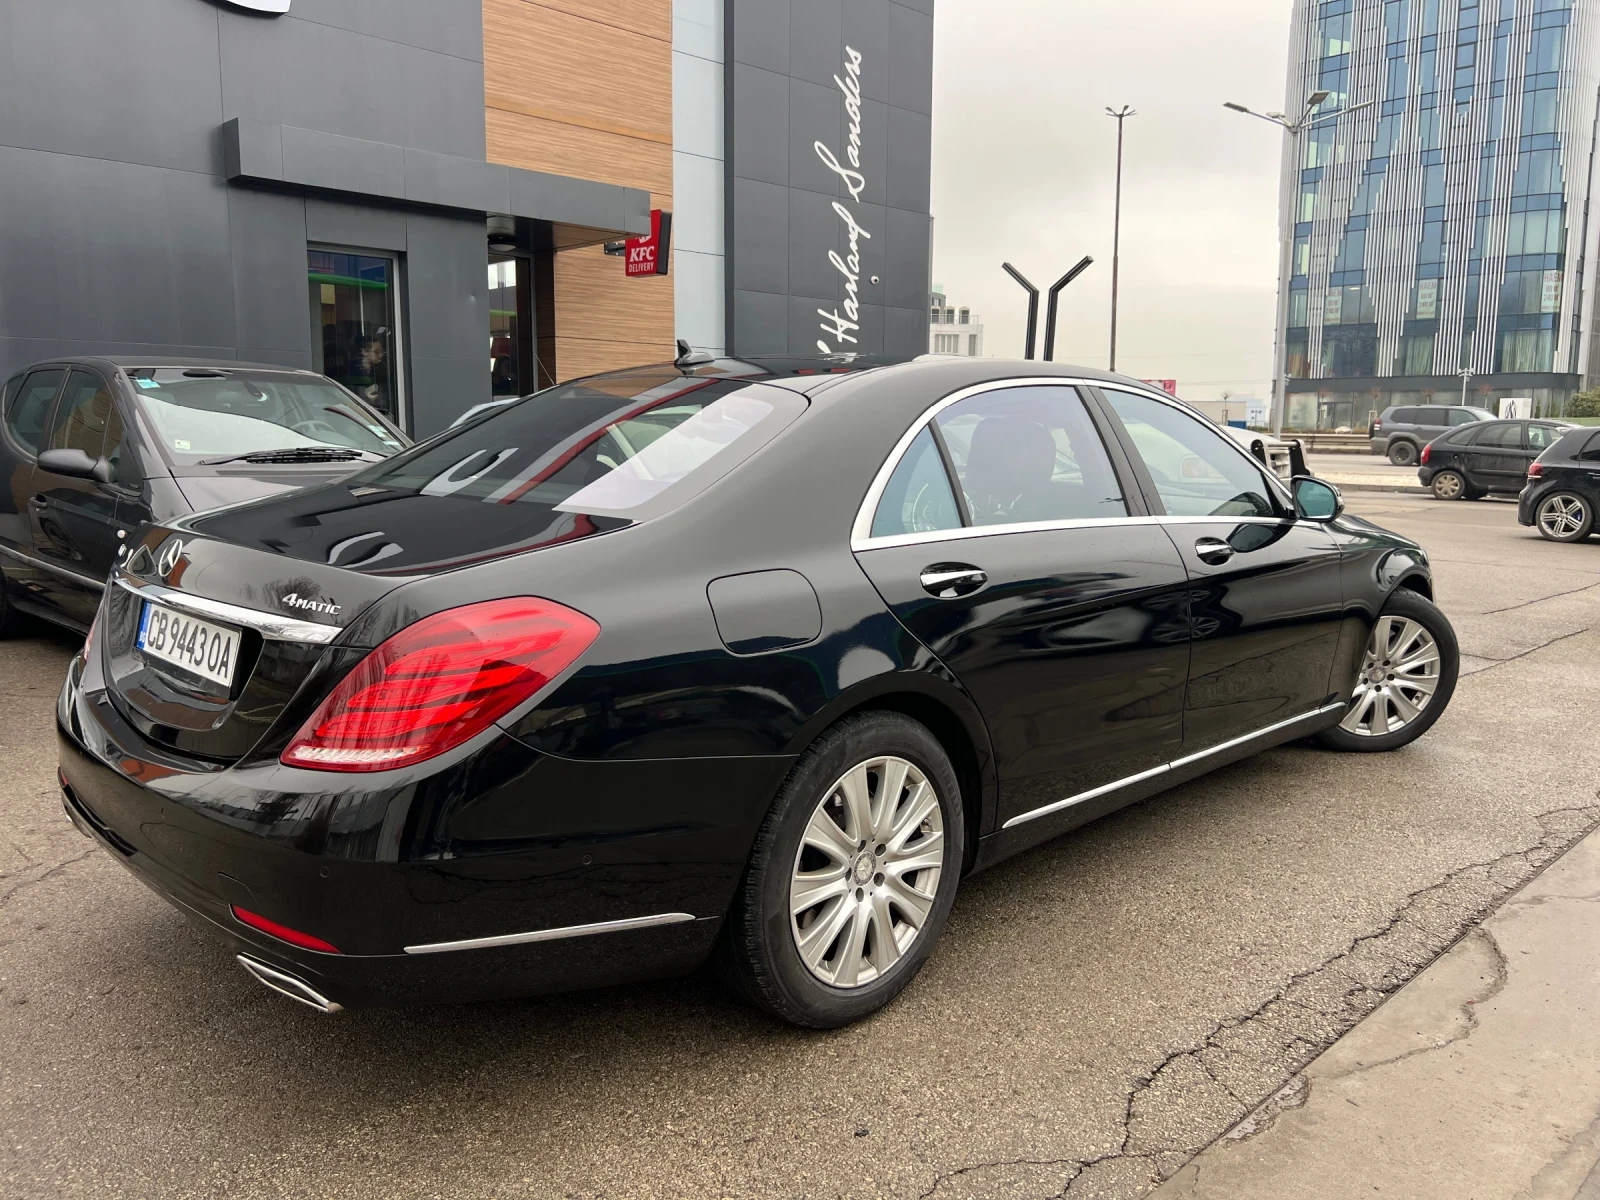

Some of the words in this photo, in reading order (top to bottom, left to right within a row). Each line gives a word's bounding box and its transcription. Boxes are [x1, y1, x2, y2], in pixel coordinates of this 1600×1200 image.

[814, 46, 865, 203] Sanders
[628, 262, 654, 272] DELIVERY
[629, 246, 654, 262] KFC
[817, 202, 870, 343] Harland
[282, 593, 342, 615] 4MATIC
[147, 610, 167, 650] CB
[168, 617, 208, 666] 9443
